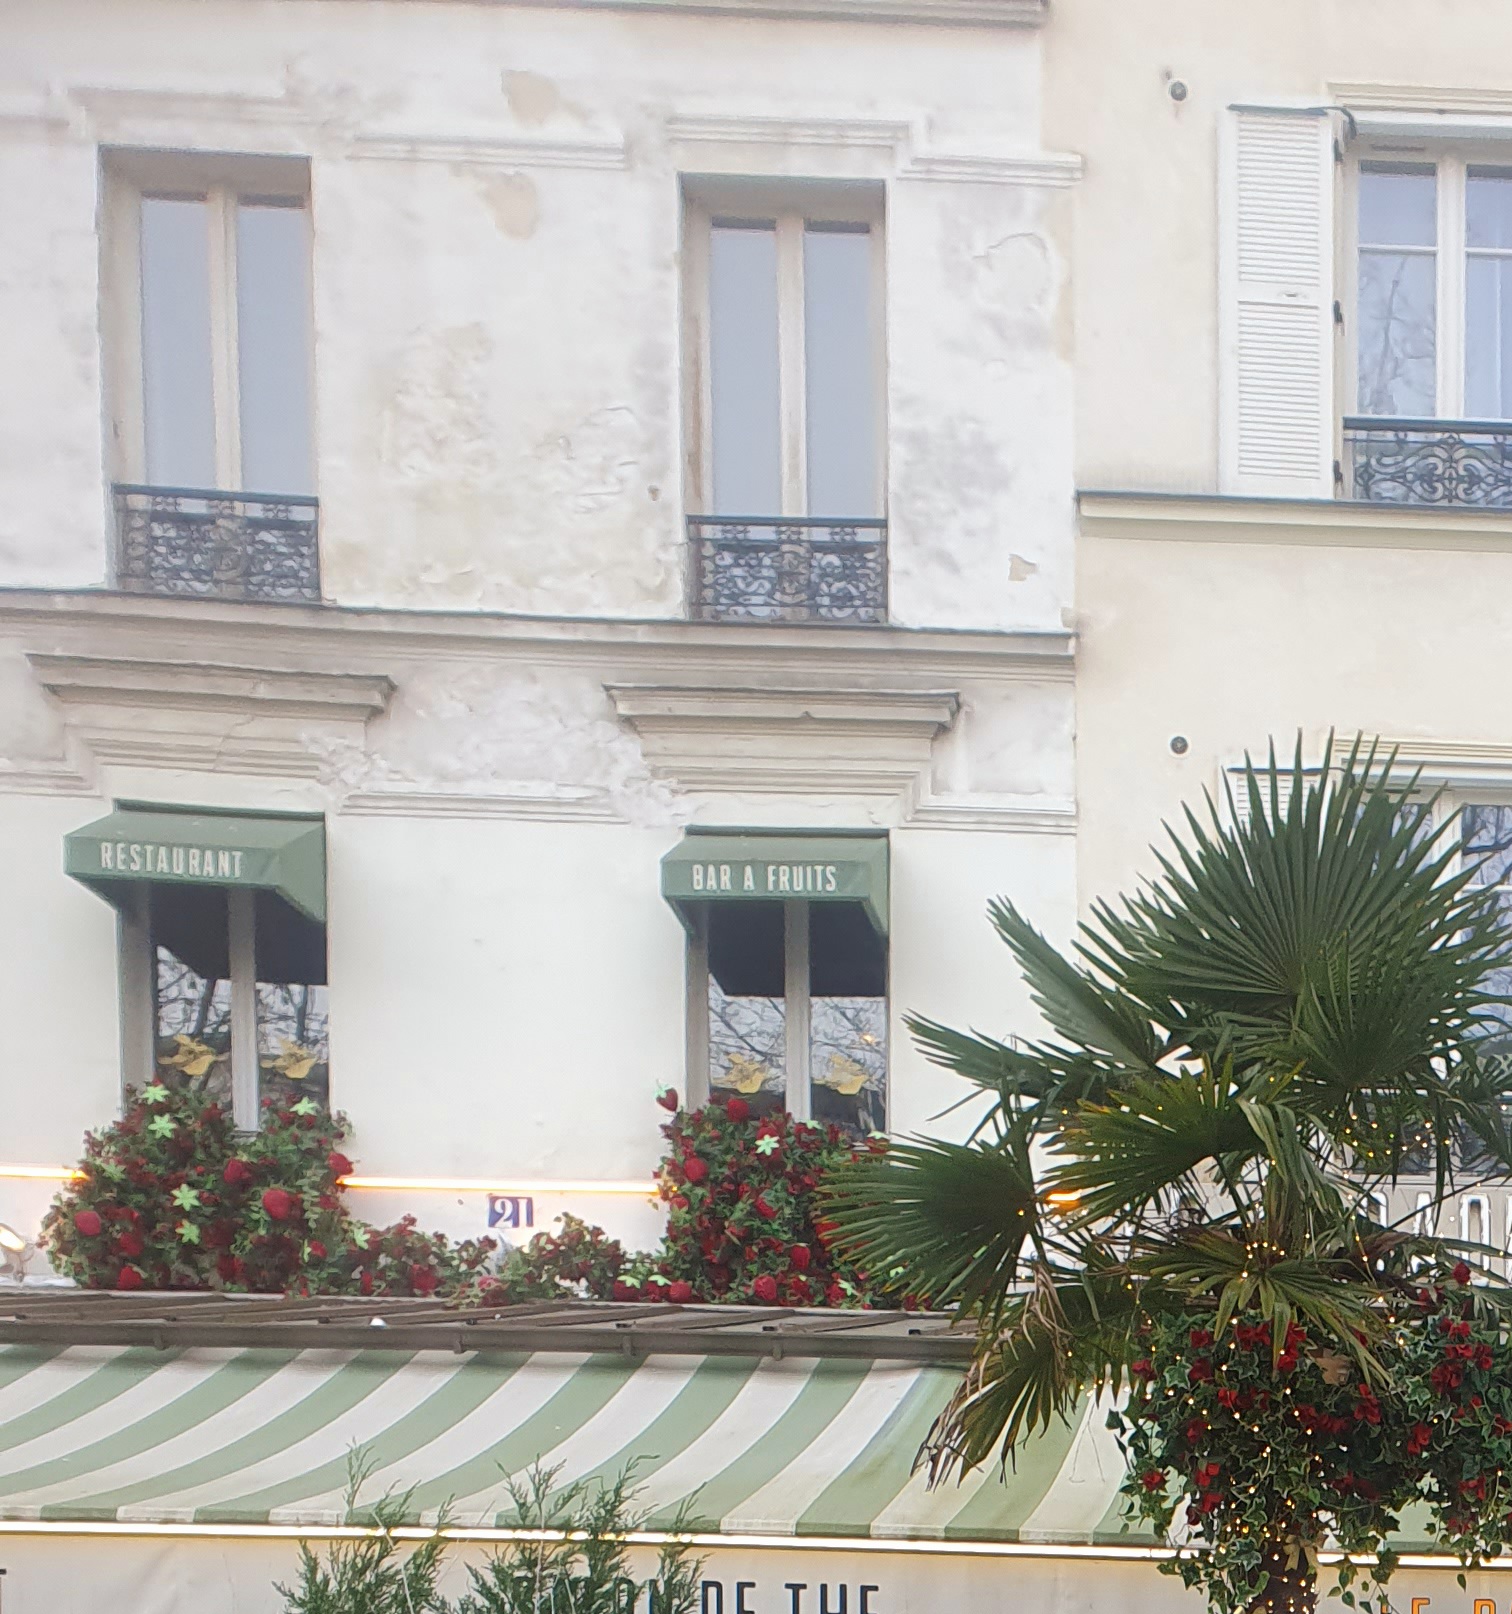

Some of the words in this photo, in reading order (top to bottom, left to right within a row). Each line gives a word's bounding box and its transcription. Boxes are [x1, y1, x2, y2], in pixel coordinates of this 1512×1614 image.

[100, 841, 244, 879] RESTAURANT
[692, 863, 732, 892] BAR
[743, 864, 755, 892] A
[766, 864, 837, 893] FRUITS
[490, 1197, 532, 1229] 21
